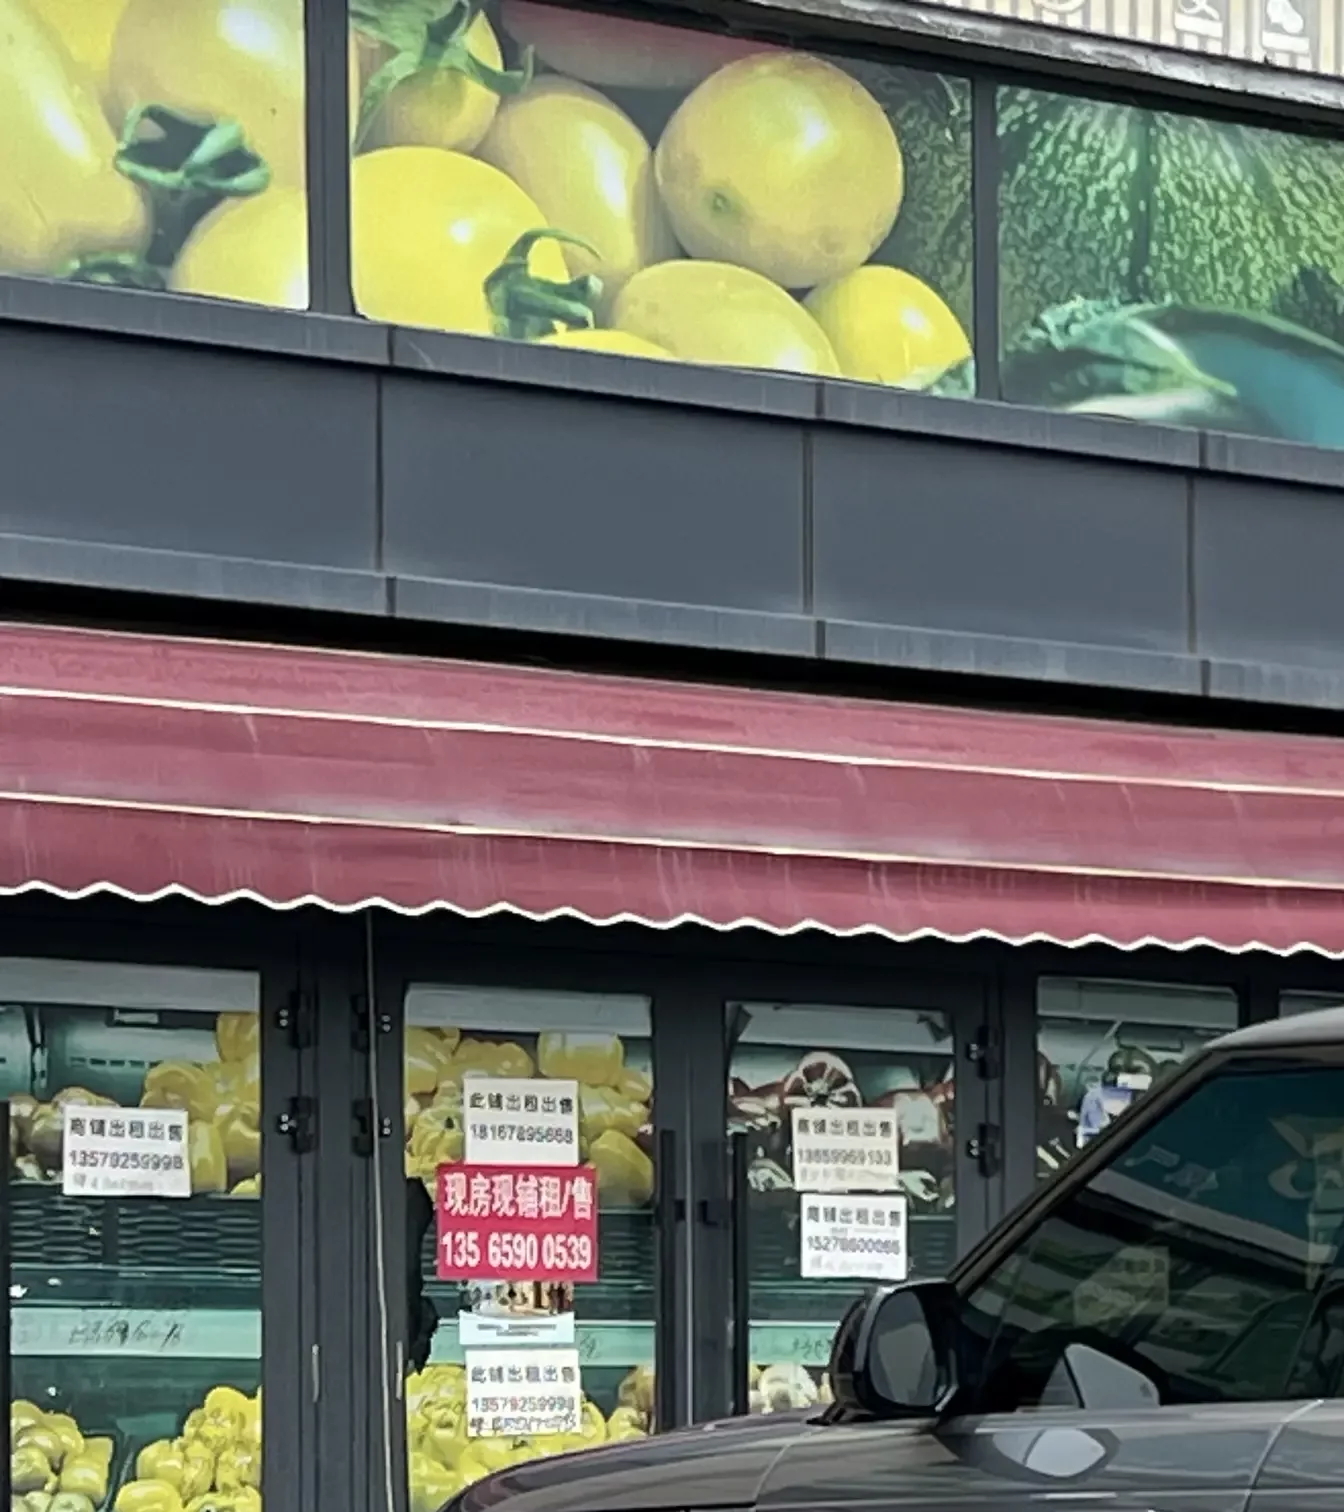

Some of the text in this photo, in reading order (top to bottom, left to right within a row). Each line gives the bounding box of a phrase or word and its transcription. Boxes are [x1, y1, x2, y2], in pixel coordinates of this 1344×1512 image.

[444, 1171, 593, 1220] 现房现铺租/售
[441, 1231, 592, 1270] 135 6590 0539
